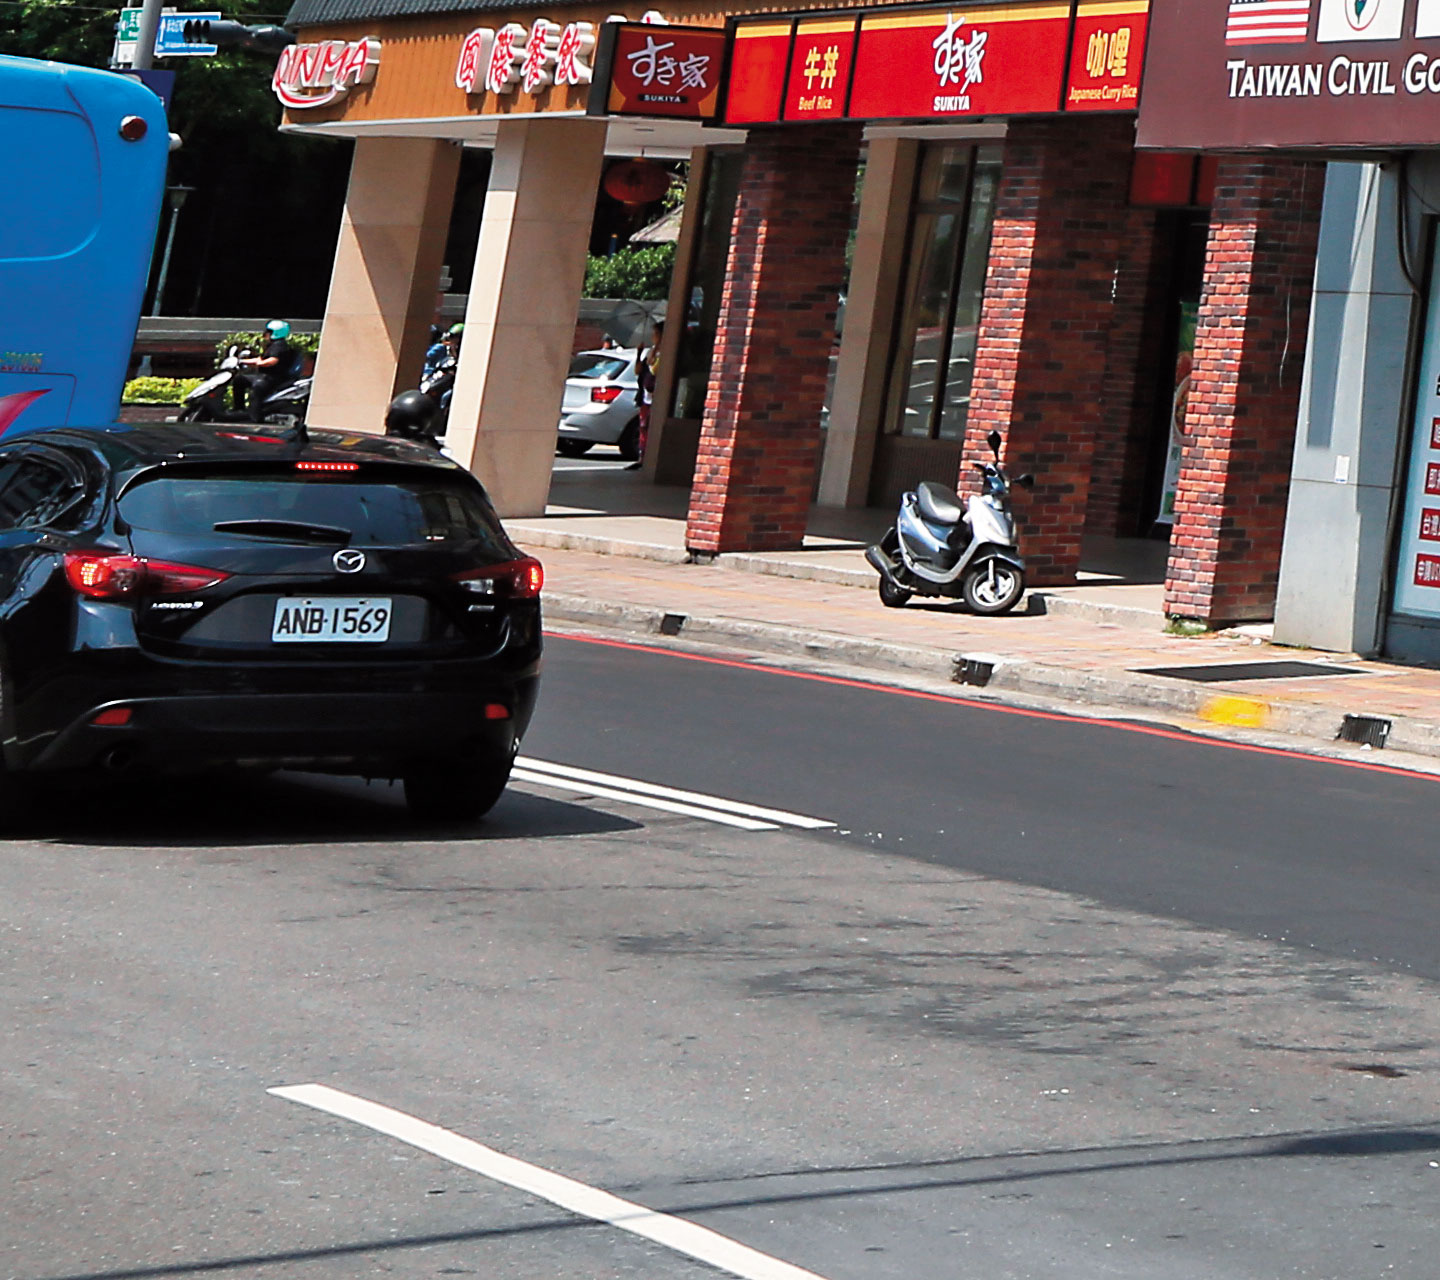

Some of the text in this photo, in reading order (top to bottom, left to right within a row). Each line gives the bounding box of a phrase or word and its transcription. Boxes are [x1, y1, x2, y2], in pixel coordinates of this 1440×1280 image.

[627, 36, 710, 93] すき家
[804, 46, 839, 90] 牛丼
[933, 13, 988, 94] すき家
[1086, 28, 1130, 78] 咖哩
[1069, 85, 1137, 102] Japanese Curry Rice
[1226, 59, 1322, 97] TAIWAN
[1328, 56, 1396, 96] CIVIL
[644, 95, 681, 103] SUKIYA
[799, 96, 832, 111] Beef Rice
[934, 96, 970, 112] SUKIYA
